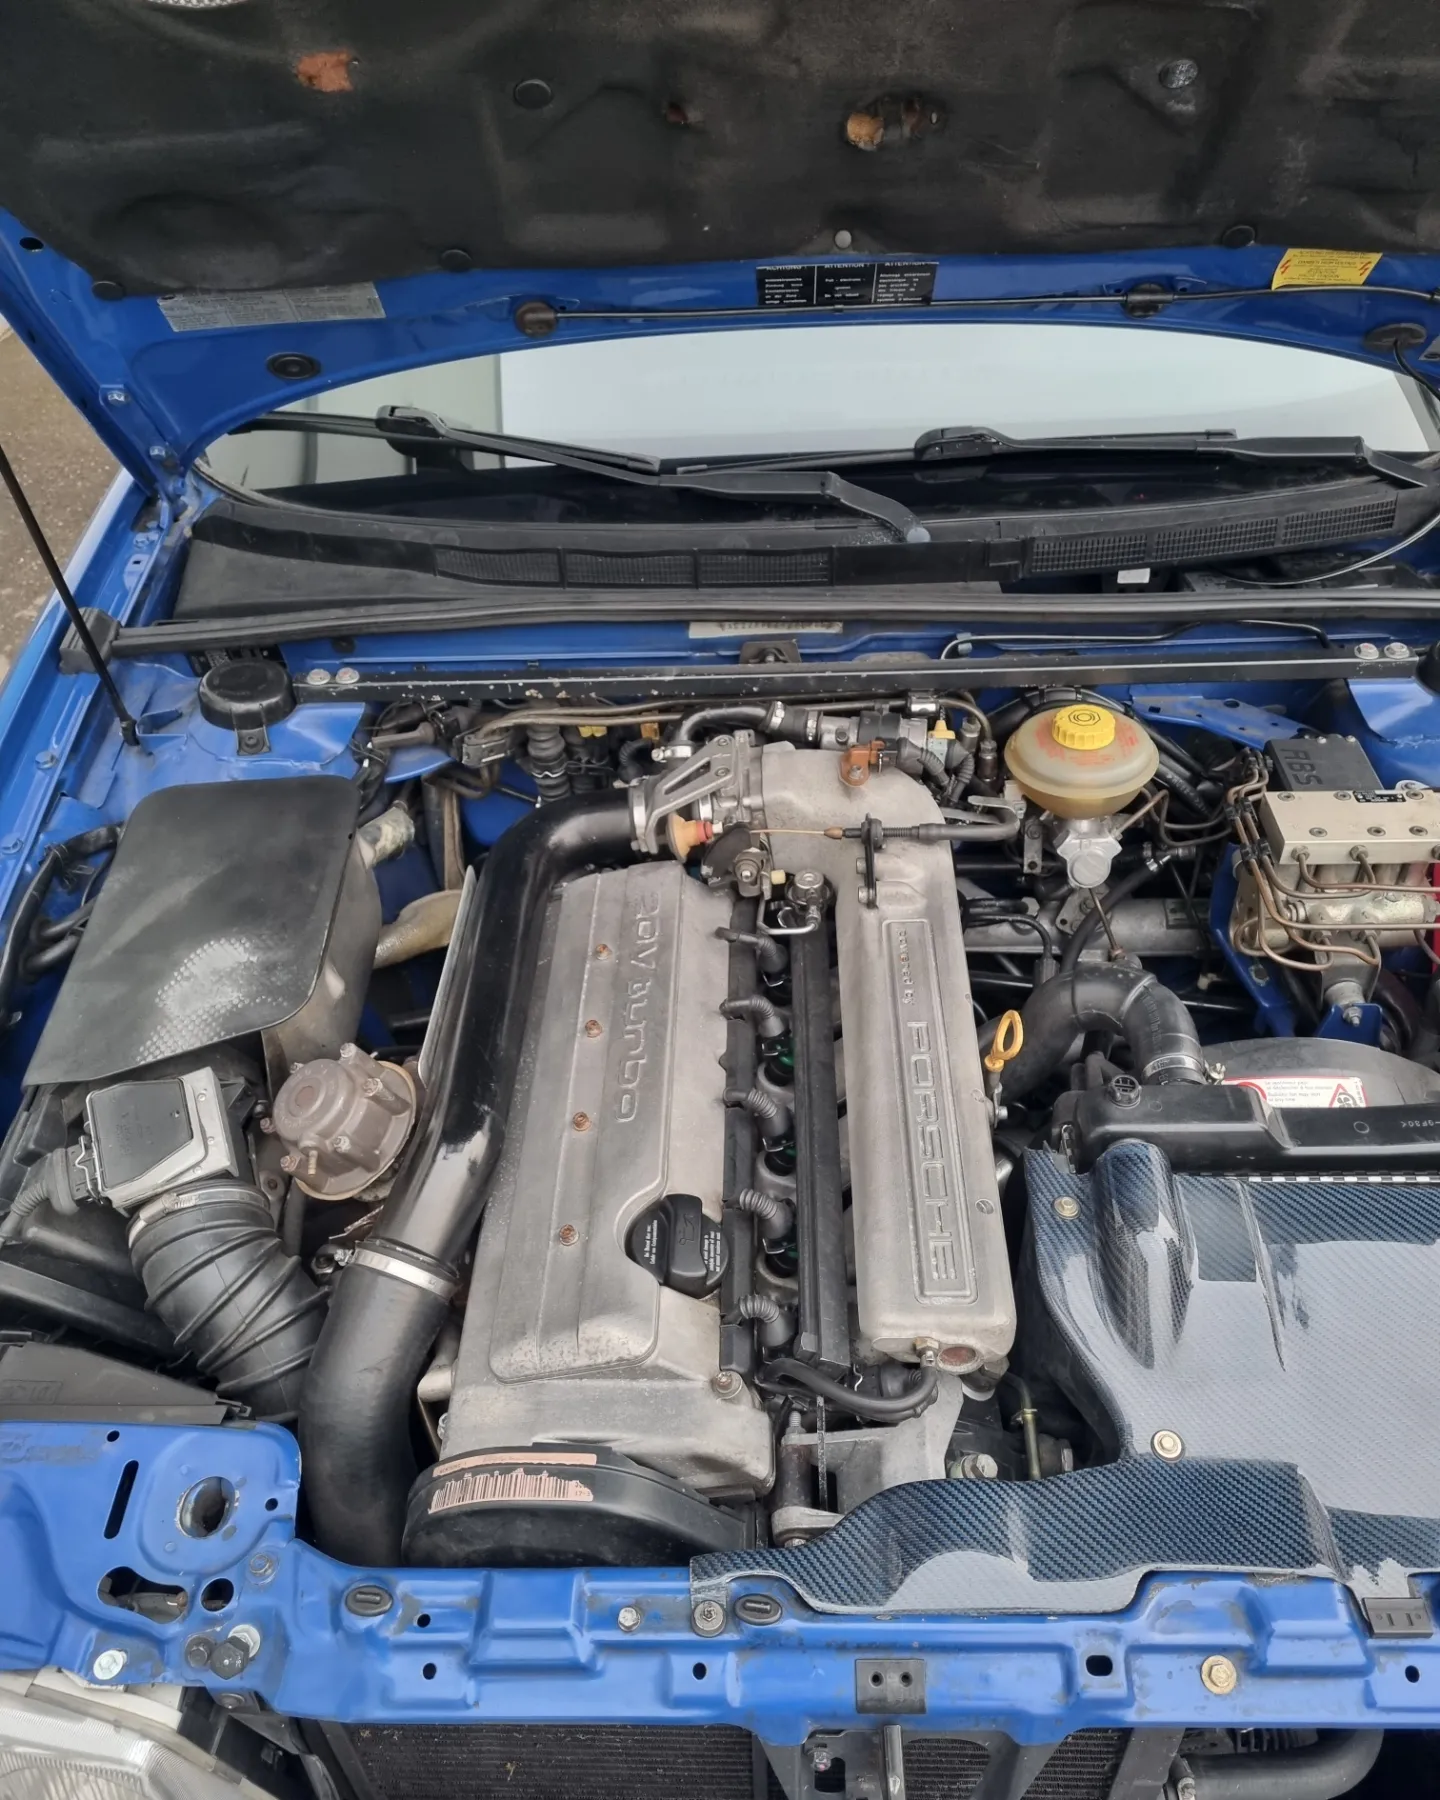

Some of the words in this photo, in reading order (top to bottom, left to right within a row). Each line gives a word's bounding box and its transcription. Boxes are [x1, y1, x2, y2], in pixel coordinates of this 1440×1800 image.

[1280, 748, 1324, 787] ABS
[630, 891, 661, 970] 20V
[895, 928, 915, 985] powered
[901, 988, 917, 1006] by
[906, 1021, 958, 1280] PORSCHE
